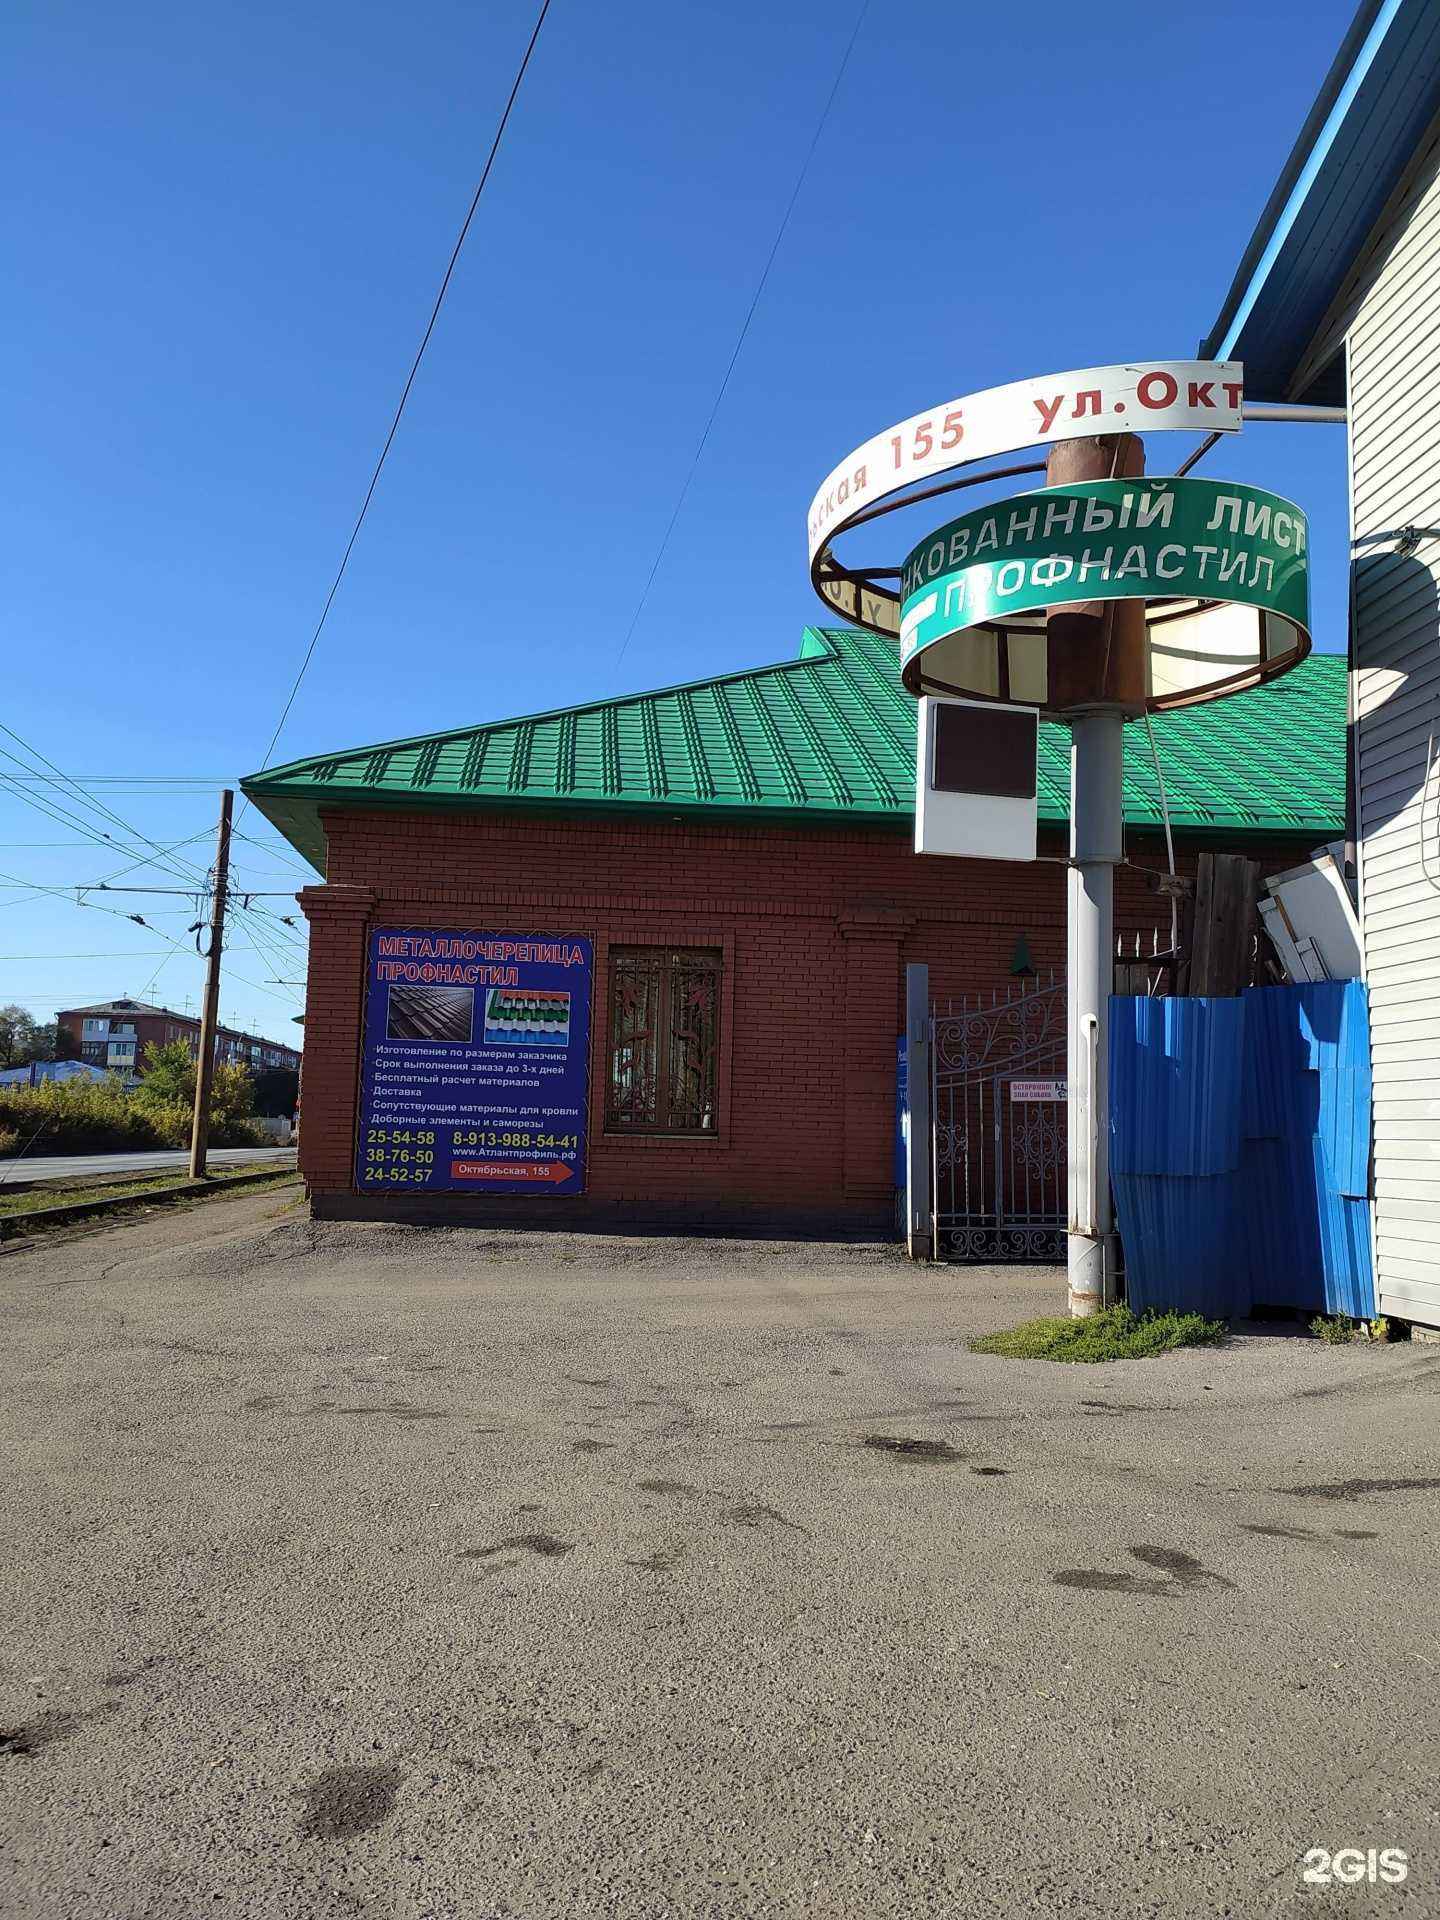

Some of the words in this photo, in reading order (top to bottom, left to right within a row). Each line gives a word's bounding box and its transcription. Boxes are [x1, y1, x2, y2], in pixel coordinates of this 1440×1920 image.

[890, 410, 965, 470] 155
[1206, 495, 1306, 557] ЛИСТ
[943, 543, 1275, 618] ПРОФНАСТИЛ
[378, 936, 584, 967] МЕТАЛЛОЧЕРЕПИЦА
[376, 961, 519, 986] ПРОФНАСТИЛ
[376, 1044, 447, 1057] Изготовление
[450, 1049, 463, 1057] по
[465, 1050, 515, 1060] размерам
[517, 1052, 567, 1061] заказчика
[375, 1058, 401, 1070] Срок
[403, 1060, 469, 1071] выполнения
[471, 1063, 504, 1072] заказа
[506, 1065, 520, 1074] до
[522, 1064, 537, 1074] 3-х
[539, 1065, 565, 1075] дней
[374, 1072, 439, 1083] Бесплатный
[441, 1076, 476, 1085] расчет
[478, 1078, 540, 1088] материалов
[373, 1086, 422, 1097] Доставка
[372, 1099, 457, 1113] Сопутствующие
[459, 1103, 518, 1115] материалы
[519, 1106, 539, 1115] для
[542, 1107, 579, 1117] кровли
[371, 1113, 427, 1126] Доборные
[429, 1116, 481, 1127] элементы
[483, 1119, 490, 1127] и
[492, 1119, 544, 1130] саморезы
[367, 1129, 435, 1146] 25-54-58
[453, 1131, 578, 1149] 8-913-988-54-41
[366, 1148, 434, 1164] 38-76-50
[452, 1148, 577, 1161] www.Атлантпрофиль.рф
[364, 1166, 433, 1182] 24-52-57
[458, 1164, 529, 1177] Октябрьская,
[532, 1166, 550, 1177] 155
